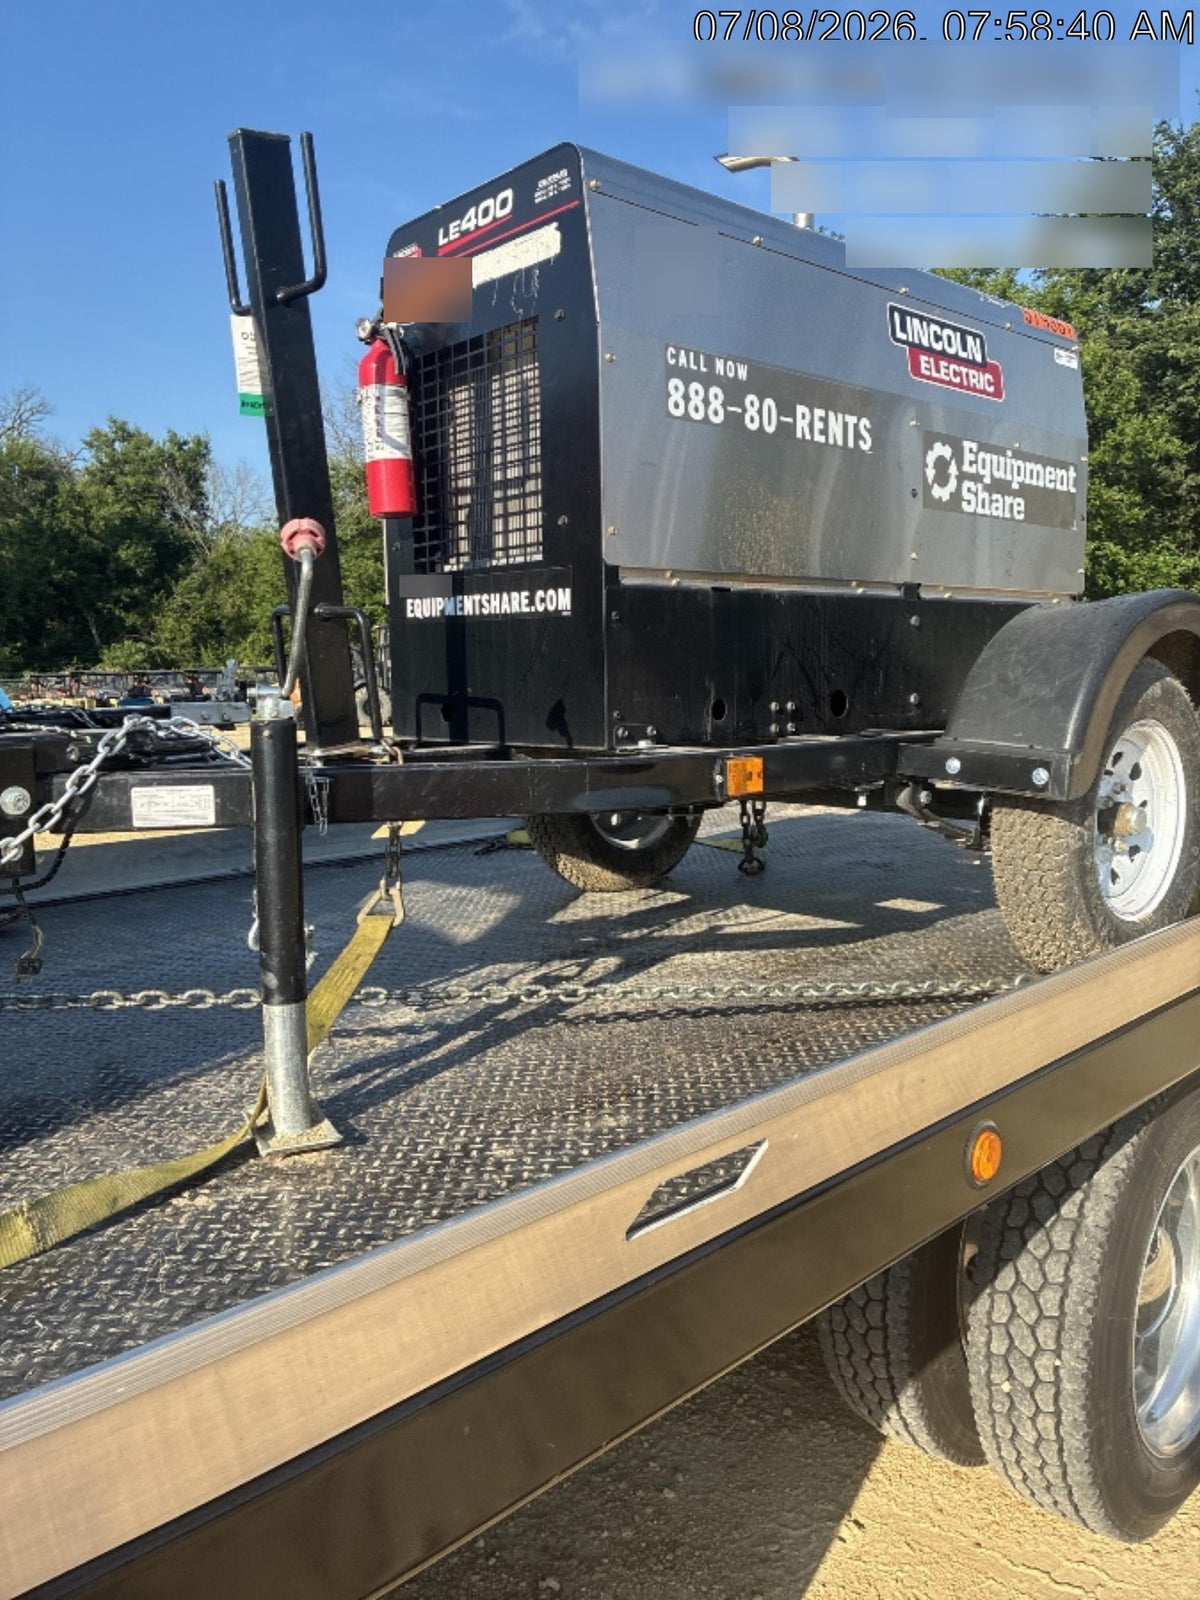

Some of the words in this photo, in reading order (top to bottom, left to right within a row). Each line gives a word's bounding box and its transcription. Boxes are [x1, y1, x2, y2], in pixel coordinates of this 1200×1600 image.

[438, 188, 514, 247] LE400
[893, 310, 983, 363] LINCOLN
[666, 346, 708, 372] CALL
[715, 357, 749, 381] NOW
[919, 354, 996, 393] ELECTRIC
[667, 377, 873, 451] 888-80-RENTS
[961, 439, 1077, 493] Equipment
[961, 480, 1026, 520] Share
[406, 587, 572, 619] EQUIPMENTSHARE.COM
